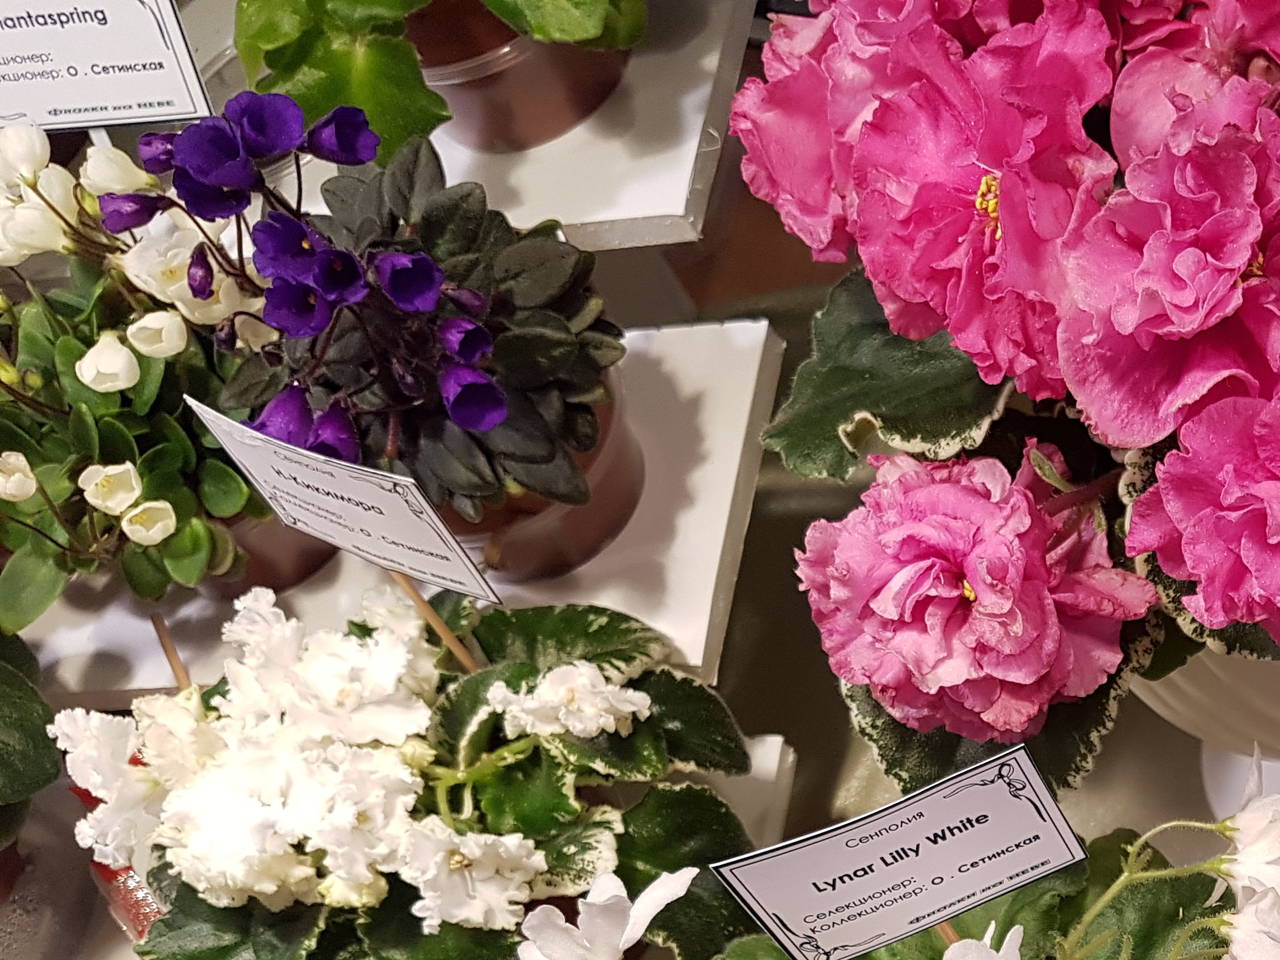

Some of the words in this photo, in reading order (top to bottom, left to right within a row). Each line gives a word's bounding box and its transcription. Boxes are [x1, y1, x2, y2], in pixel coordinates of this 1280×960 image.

[90, 61, 165, 75] Сетинская
[812, 863, 876, 893] Lynar
[879, 843, 920, 867] Lilly
[925, 814, 990, 845] White
[845, 811, 925, 849] Сенполия
[803, 876, 917, 924] Селекционер:
[809, 884, 929, 934] Коллекционер:
[958, 834, 1041, 873] Сетинская
